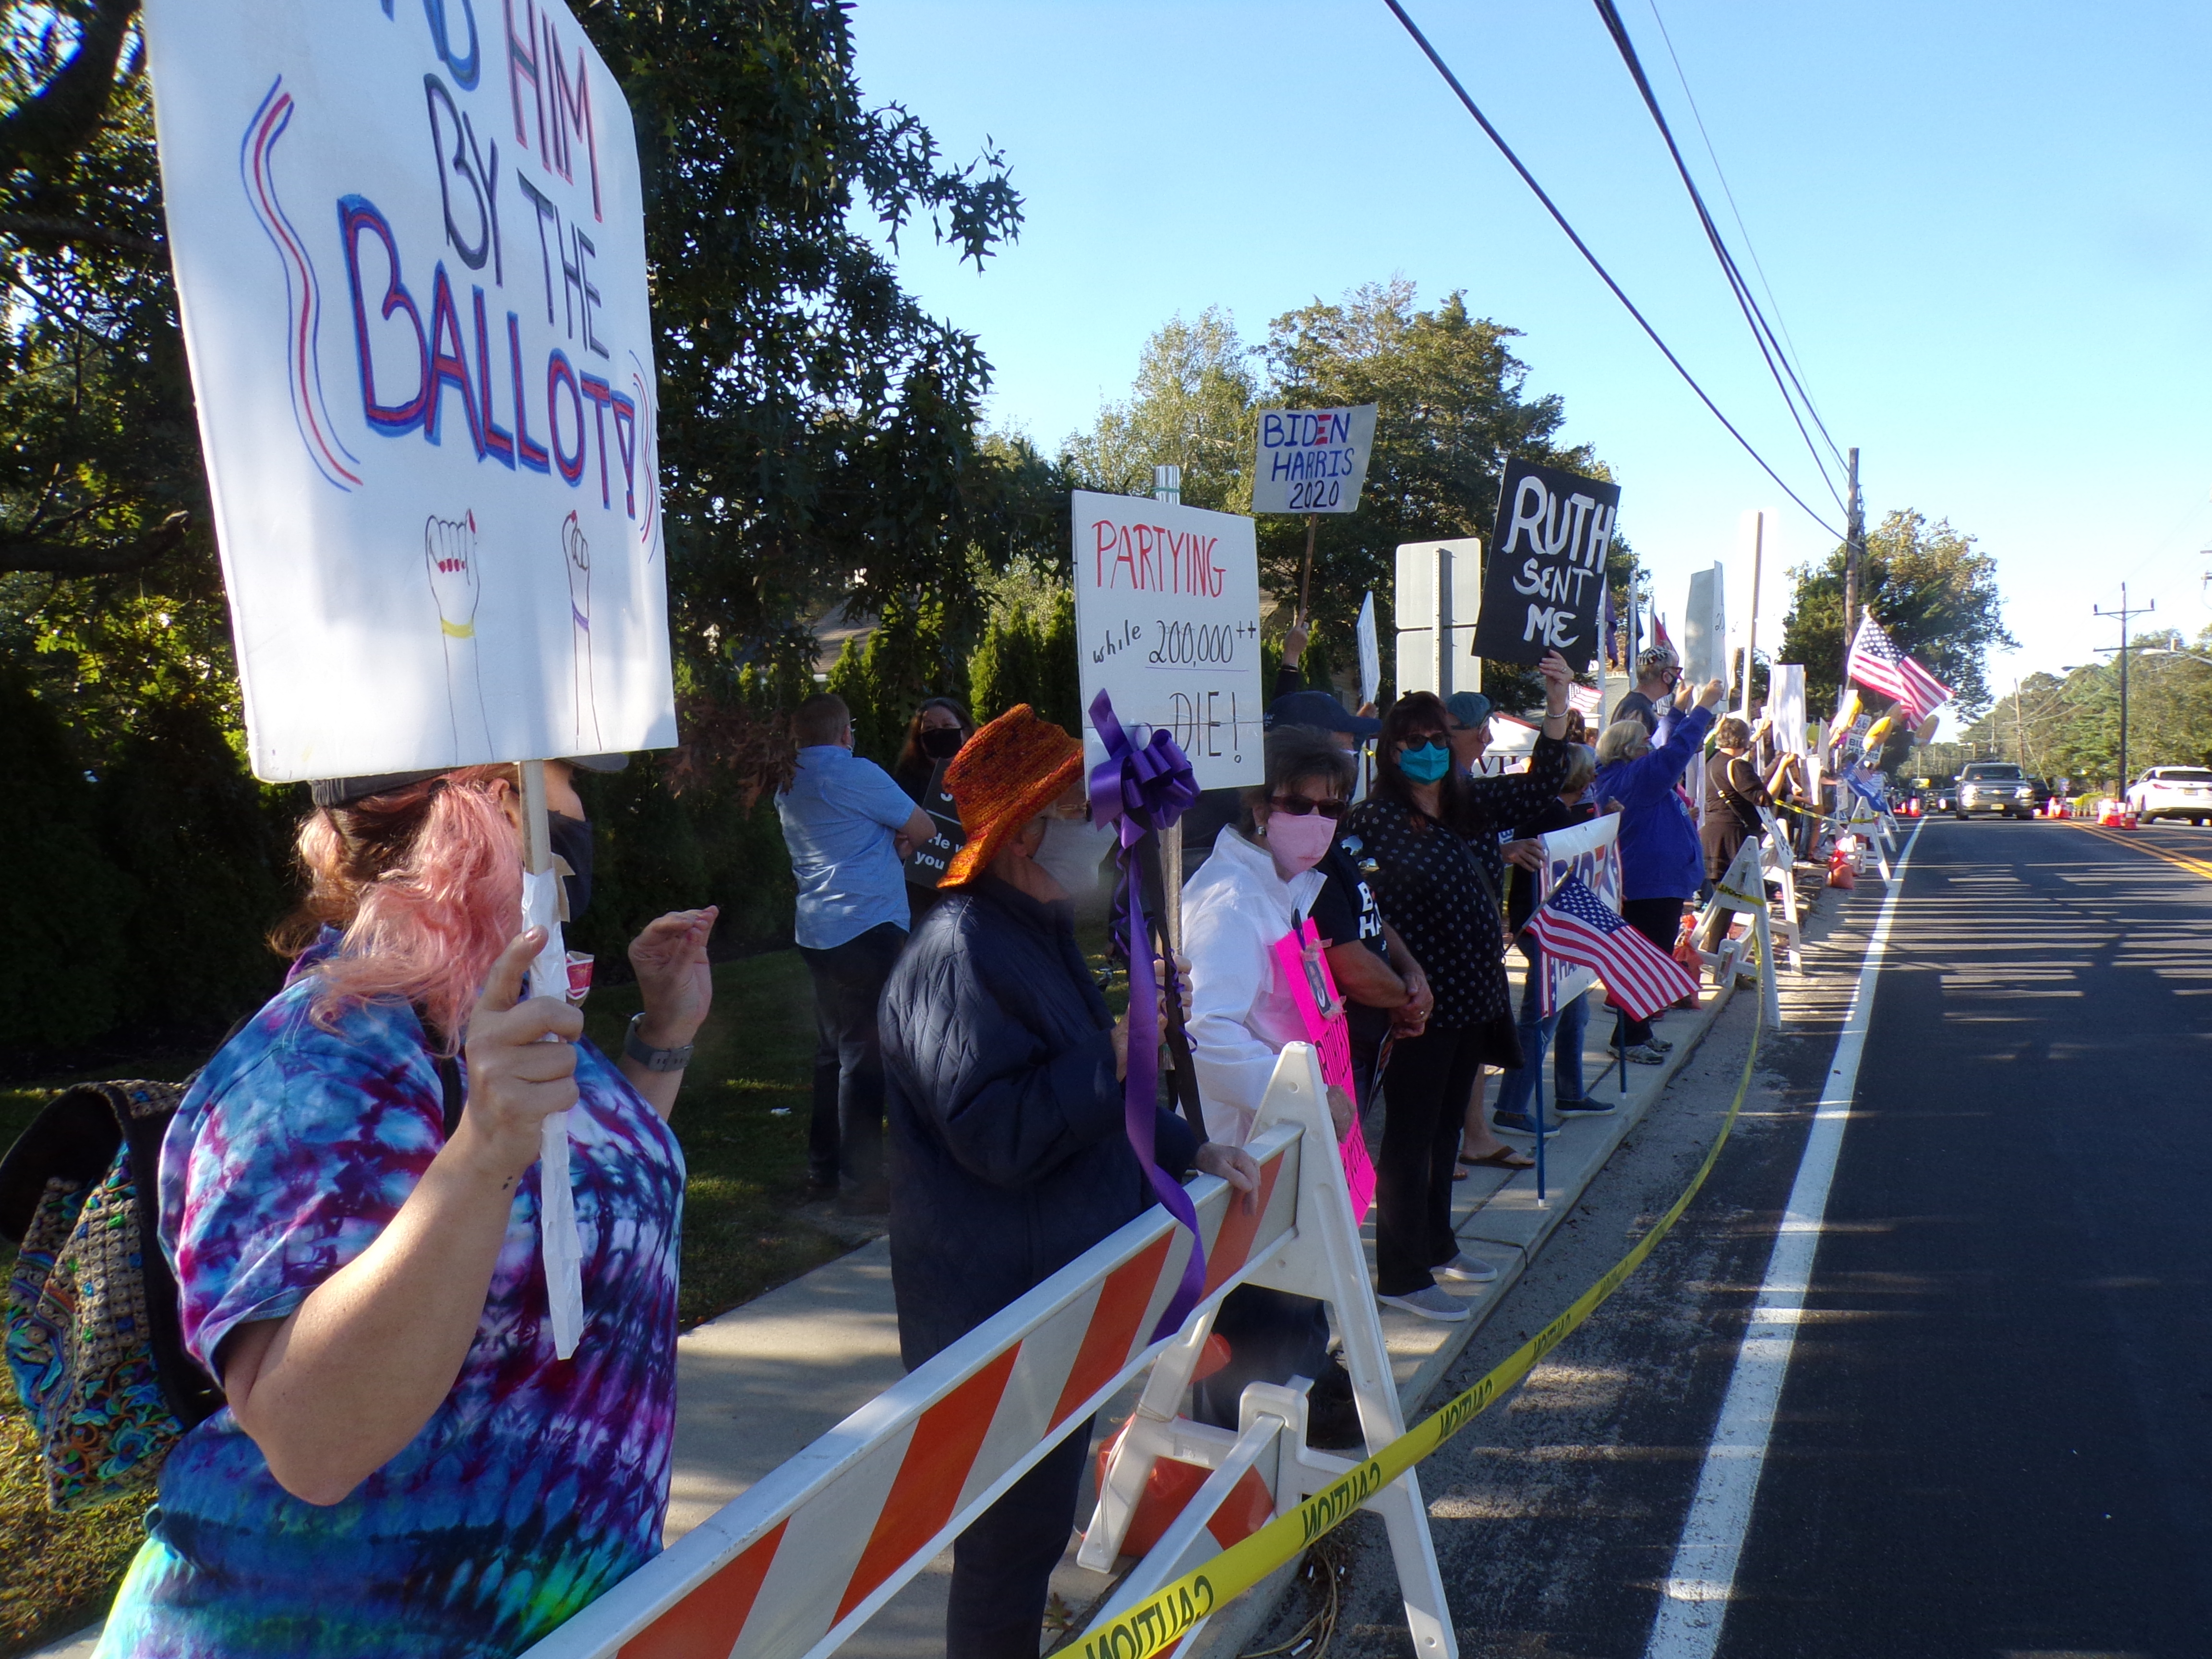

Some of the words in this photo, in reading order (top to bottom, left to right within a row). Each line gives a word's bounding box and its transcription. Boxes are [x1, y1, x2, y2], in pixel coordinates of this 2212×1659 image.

[500, 0, 603, 224] HIM
[423, 72, 503, 288] BY
[516, 168, 610, 362] THE
[1263, 413, 1350, 448] BIDEN
[1271, 448, 1355, 481] HARRIS
[1289, 480, 1339, 509] 2020
[1502, 476, 1616, 574] RUTH
[1092, 519, 1226, 598] PARTYING
[1513, 558, 1594, 606] SENT
[1093, 619, 1142, 663] while
[1523, 603, 1579, 648] ME
[914, 851, 945, 870] you
